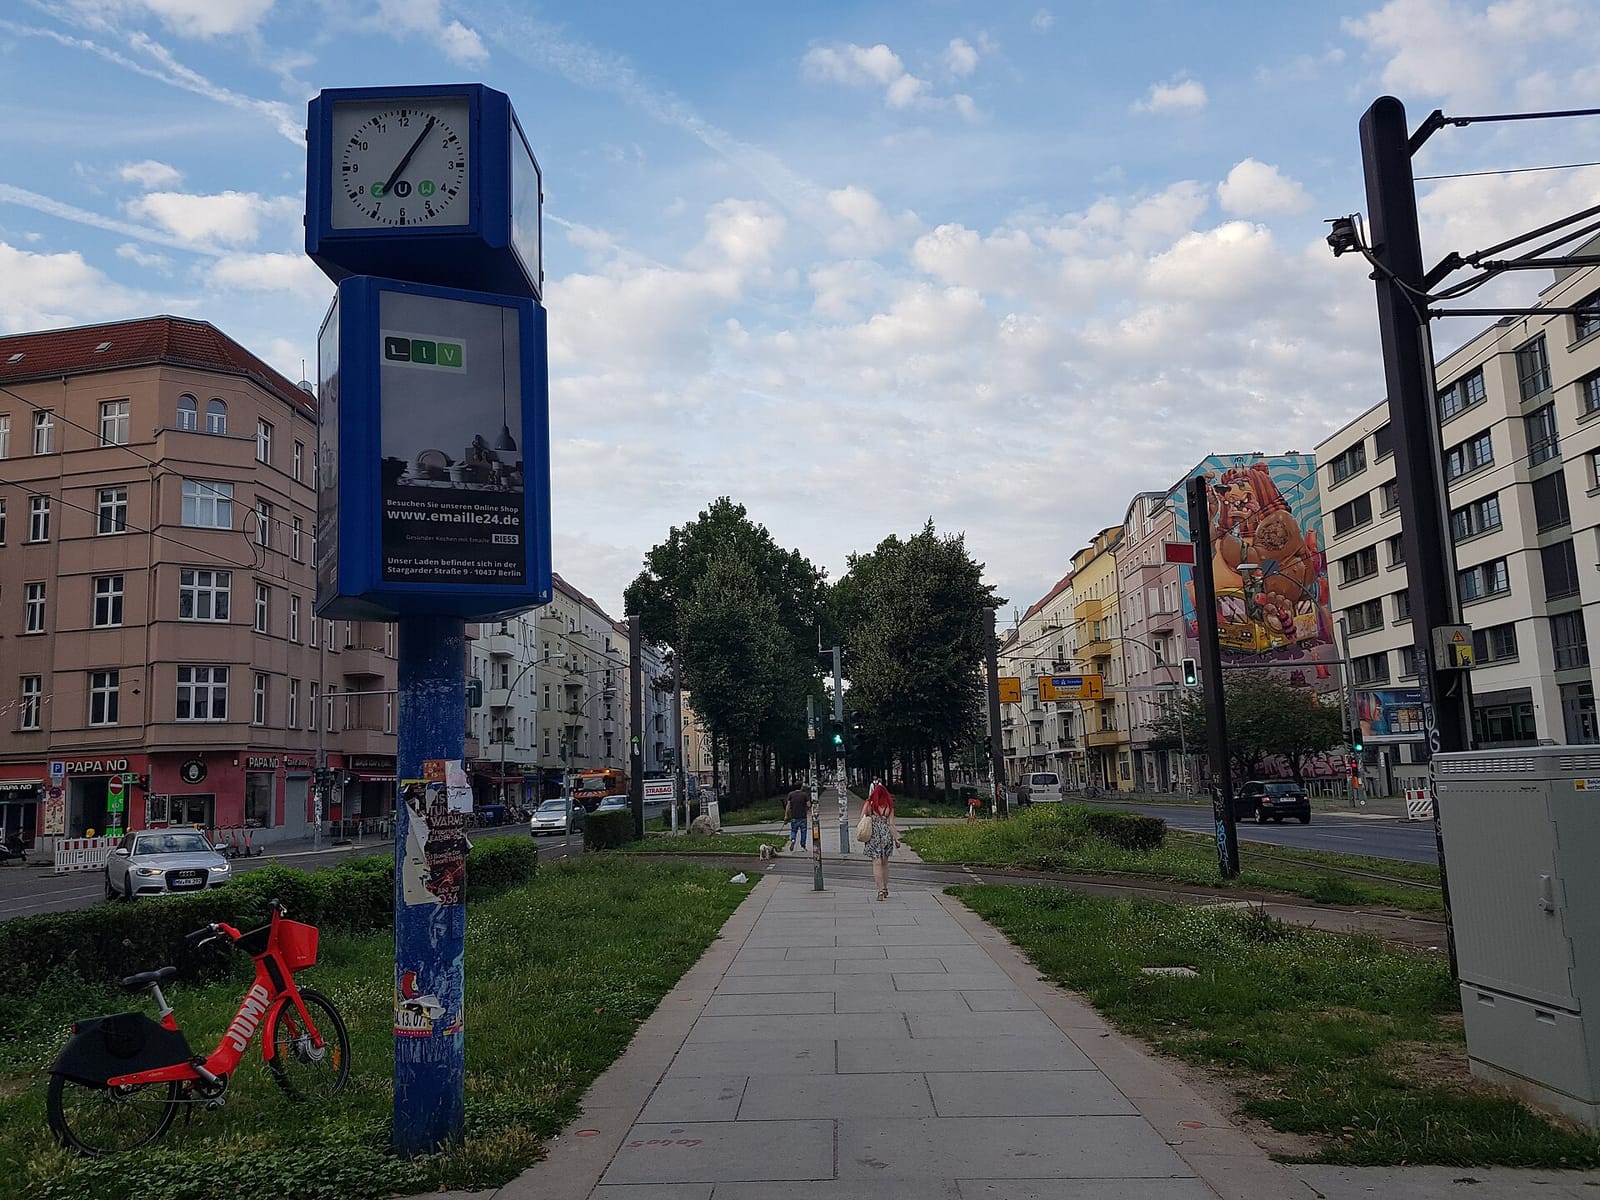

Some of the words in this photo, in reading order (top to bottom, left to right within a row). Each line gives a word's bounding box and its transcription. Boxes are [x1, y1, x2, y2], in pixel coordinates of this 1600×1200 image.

[398, 118, 410, 127] 12
[377, 125, 386, 134] 11
[358, 142, 368, 151] 10
[387, 499, 426, 508] Besuchen
[474, 504, 499, 512] Online
[500, 506, 519, 514] Shop
[387, 510, 520, 526] www.emaille24.de
[494, 535, 518, 544] RIESS
[414, 558, 439, 566] Laden
[441, 559, 475, 567] befindet
[476, 560, 493, 568] sich
[387, 566, 432, 576] Stargarder
[66, 761, 102, 773] PAPA
[250, 757, 268, 768] PAPA
[226, 984, 270, 1052] JUMP
